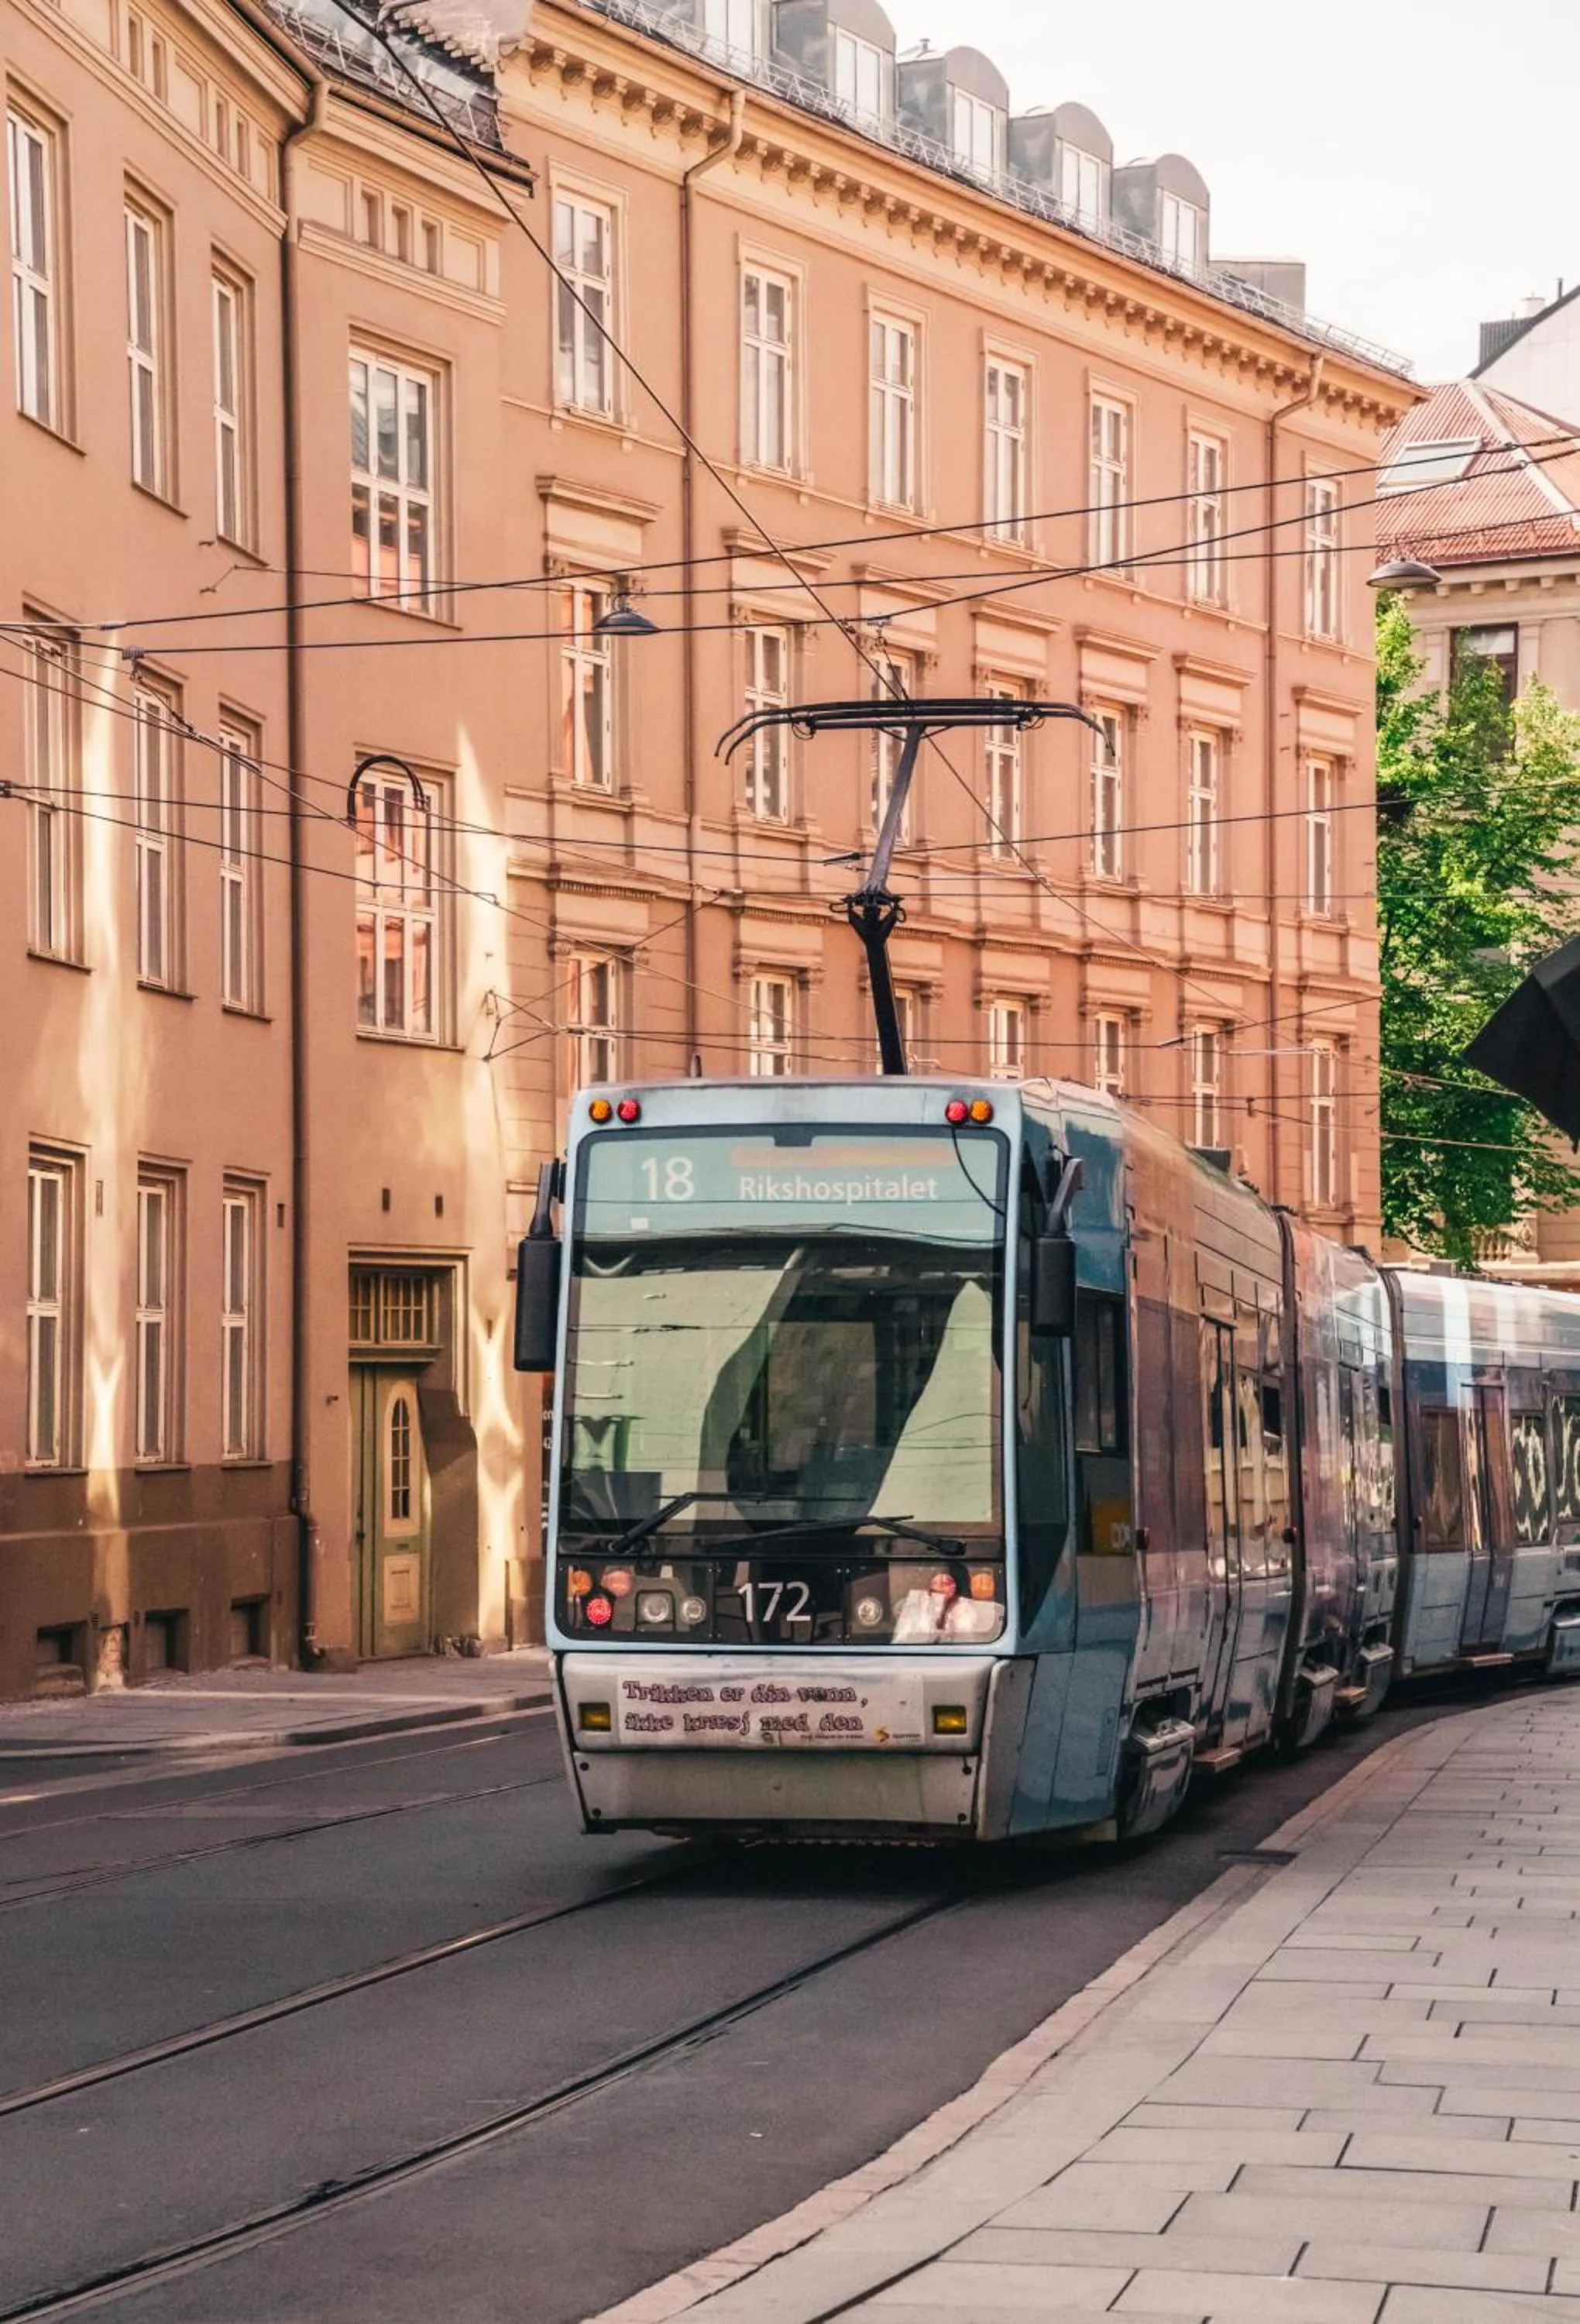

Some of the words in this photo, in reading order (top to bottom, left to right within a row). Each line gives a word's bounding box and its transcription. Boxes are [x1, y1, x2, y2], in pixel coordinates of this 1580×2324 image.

[641, 1156, 695, 1201] 18
[740, 1174, 939, 1206] Rikshospitalet
[737, 1581, 811, 1622] 172
[623, 1681, 715, 1703] Trikken
[720, 1686, 745, 1702] er
[750, 1683, 792, 1703] din
[624, 1712, 675, 1731] ikke
[759, 1713, 810, 1731] med
[819, 1713, 864, 1731] den
